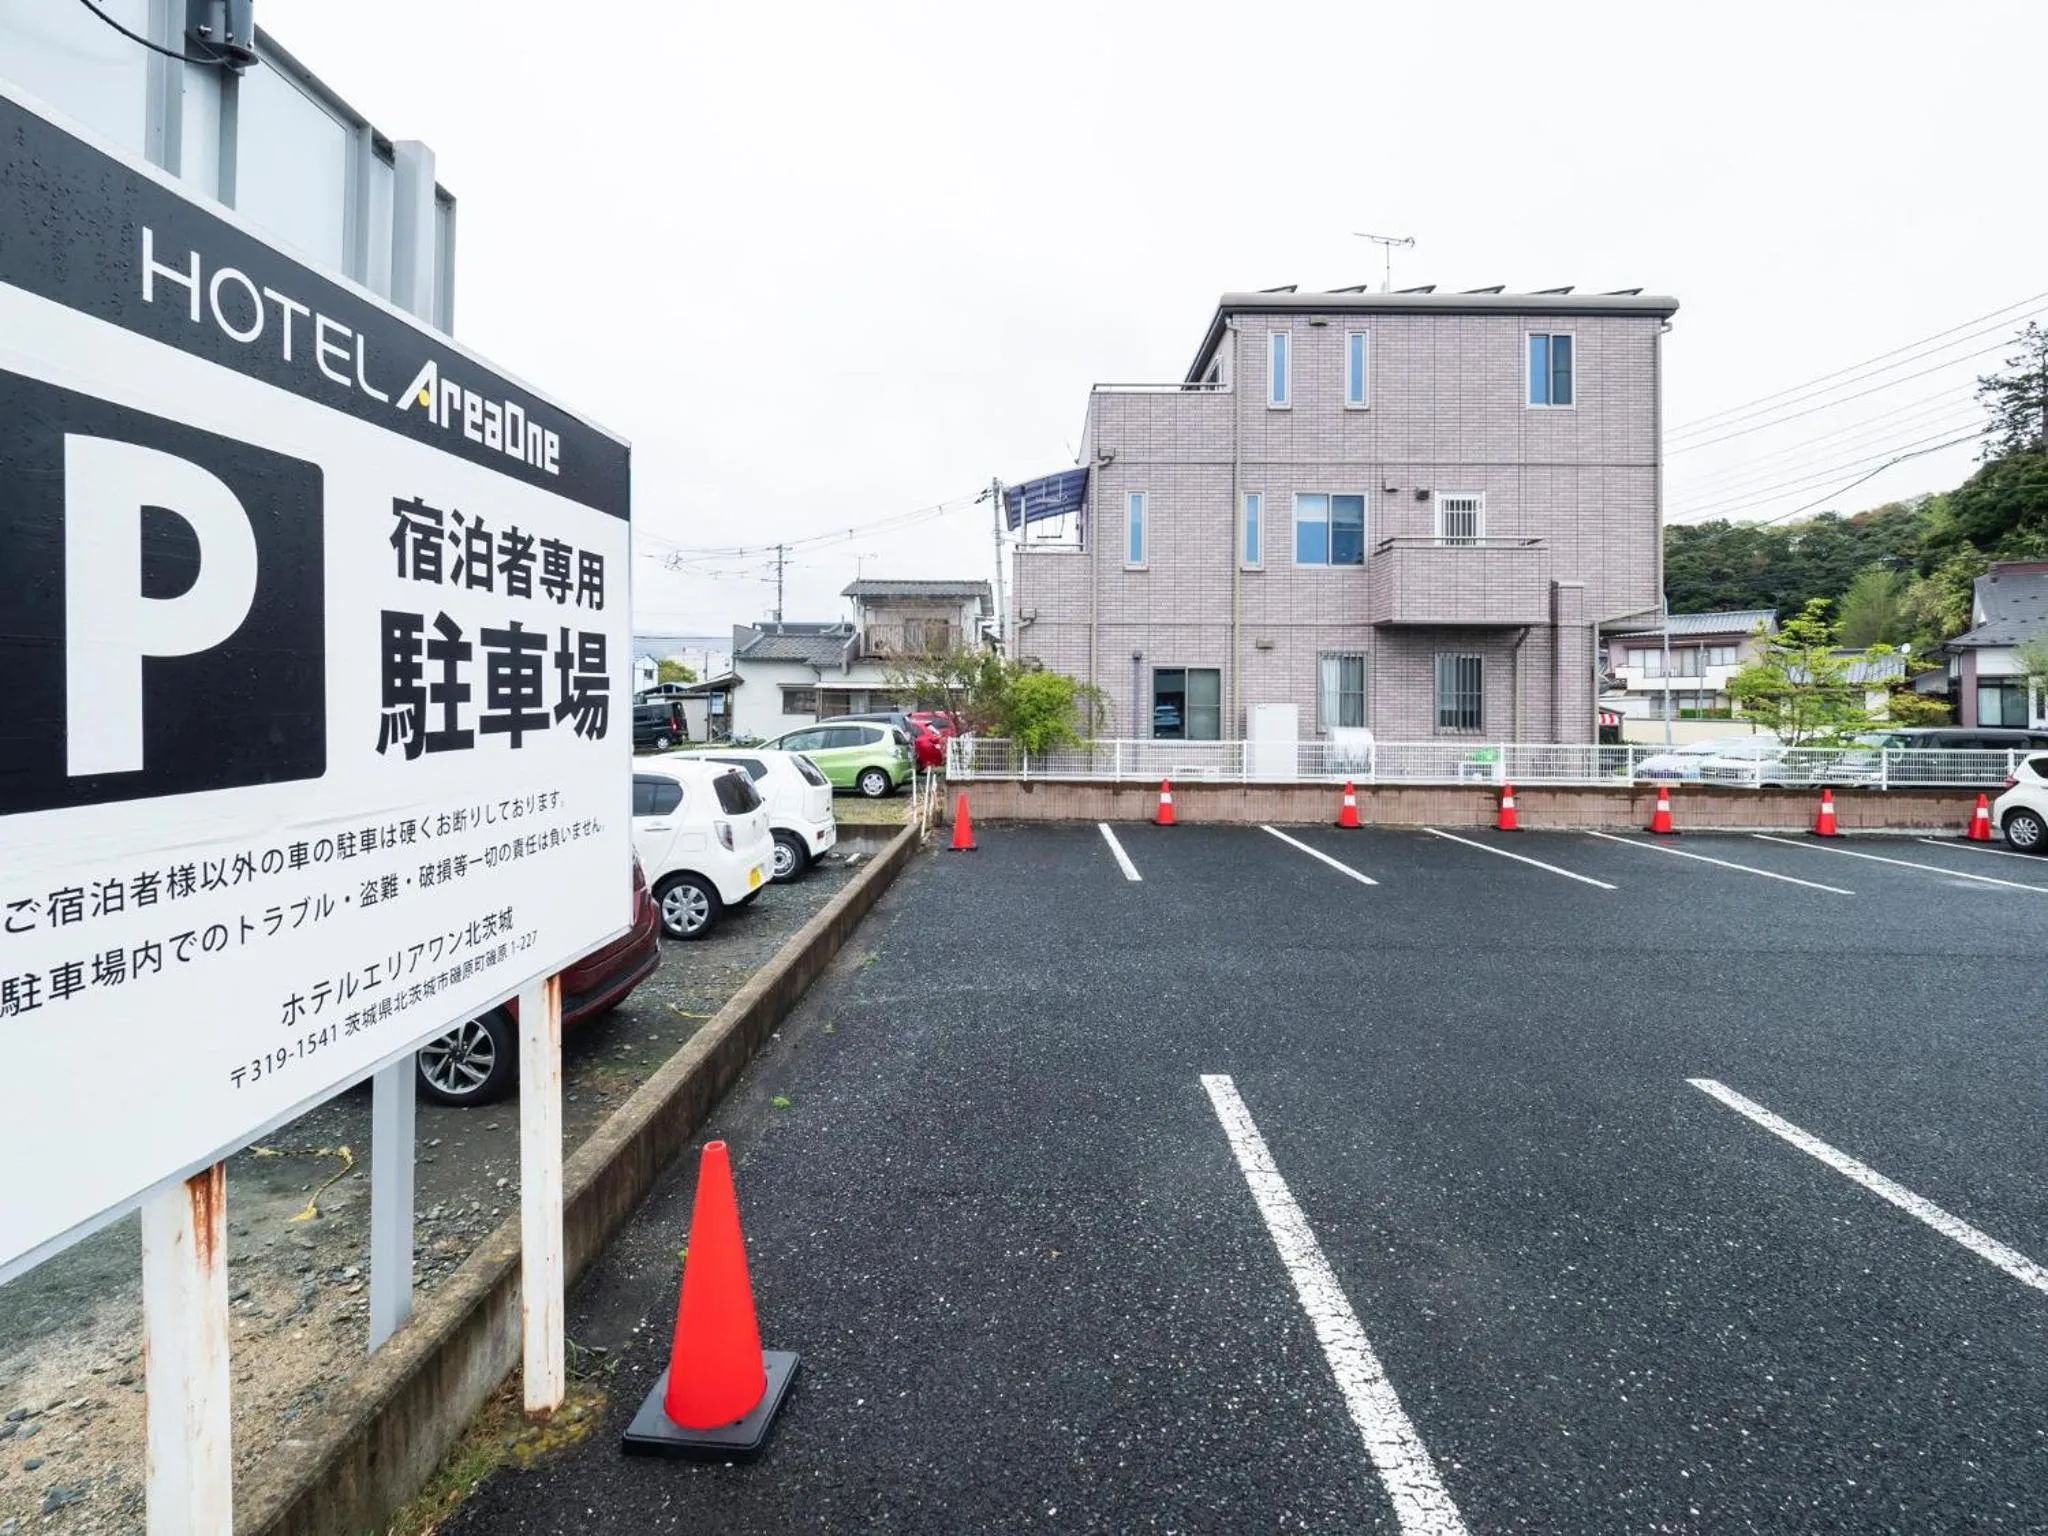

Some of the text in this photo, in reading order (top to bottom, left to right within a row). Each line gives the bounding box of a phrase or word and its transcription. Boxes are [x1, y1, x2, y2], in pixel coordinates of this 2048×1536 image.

[142, 226, 561, 476] HOTEL AreaOne
[64, 433, 258, 777] P
[390, 496, 606, 611] 宿泊者専用
[375, 609, 610, 761] 駐車場
[5, 788, 566, 934] ご宿泊者様以外の車の駐車は硬くお断りしております。
[281, 905, 514, 1027] ホテルエリアワン北茨城
